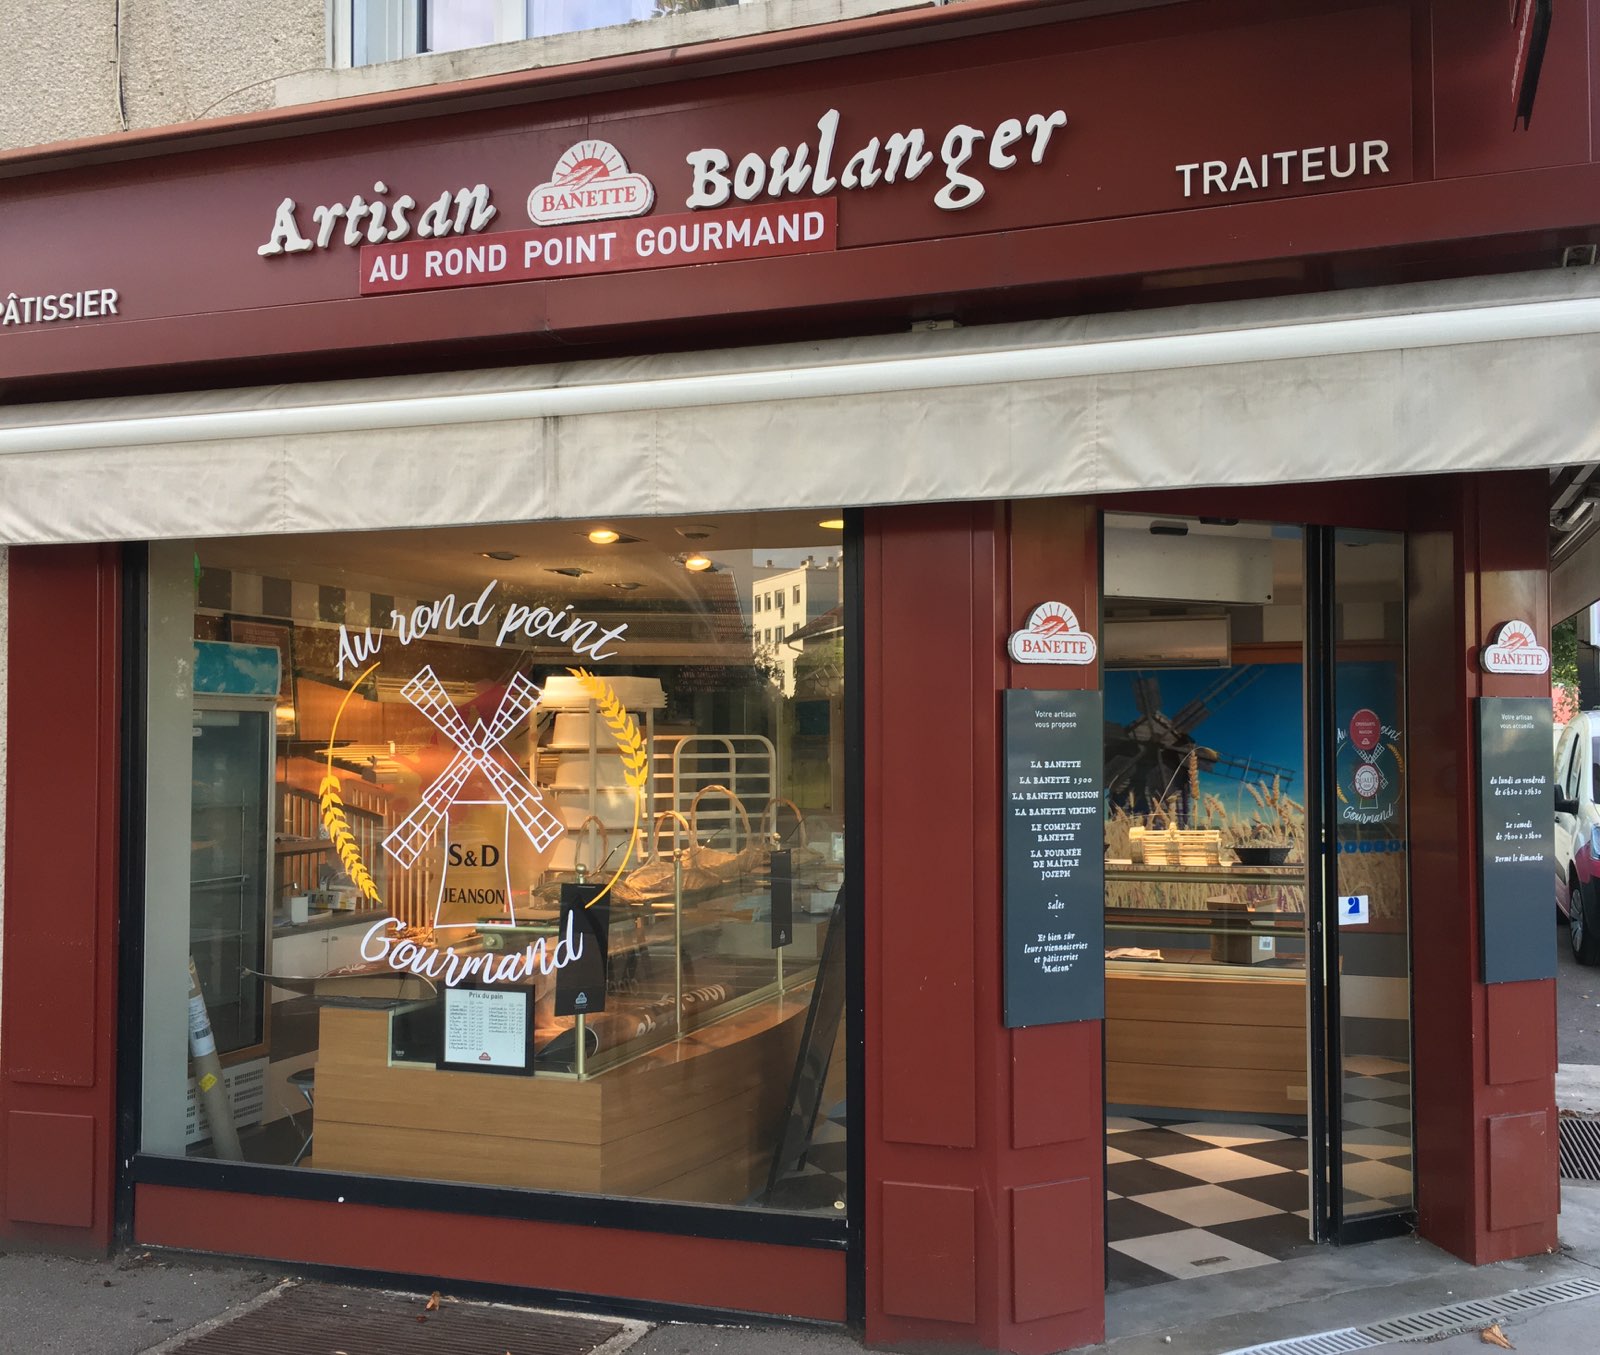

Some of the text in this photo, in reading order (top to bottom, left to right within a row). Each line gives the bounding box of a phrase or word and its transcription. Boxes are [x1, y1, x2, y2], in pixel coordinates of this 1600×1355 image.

[1176, 139, 1390, 197] TRAITEUR
[257, 109, 1068, 257] Artisan Boulanger
[540, 184, 637, 214] BANETTE
[368, 209, 826, 283] AU ROND POINT GOURMAND
[336, 579, 629, 681] Au rond point
[1022, 639, 1088, 655] BANETTE
[1492, 652, 1543, 666] BANETTE
[1034, 710, 1077, 718] Votre artisan
[1051, 722, 1077, 730] propose
[1380, 725, 1402, 741] oint
[1030, 760, 1081, 769] LA BANETTE
[1019, 776, 1093, 785] LA BANETTE 1900
[1498, 776, 1514, 784] lundi
[1522, 775, 1546, 784] vendredi
[1012, 790, 1099, 800] LA BANETTE MOISSON
[1495, 788, 1502, 796] de
[1014, 806, 1096, 816] LA BANETTE VIKING
[1343, 803, 1394, 825] Gourmand
[1031, 822, 1082, 831] LE COMPLET
[1513, 820, 1533, 829] samedi
[1037, 833, 1075, 842] BANETTE
[1496, 832, 1503, 841] de
[1030, 848, 1082, 858] LA FOURNÉE
[1512, 853, 1518, 862] le
[1518, 853, 1544, 862] dimanche
[1033, 858, 1080, 868] DE MAÎTRE
[1041, 870, 1071, 881] JOSEPH
[443, 887, 506, 906] JEANSON
[1037, 931, 1076, 942] Et bien sûr
[360, 909, 586, 989] Gourmand
[1024, 941, 1089, 954] leurs viennoiseries
[1034, 953, 1079, 967] et pâtisseries
